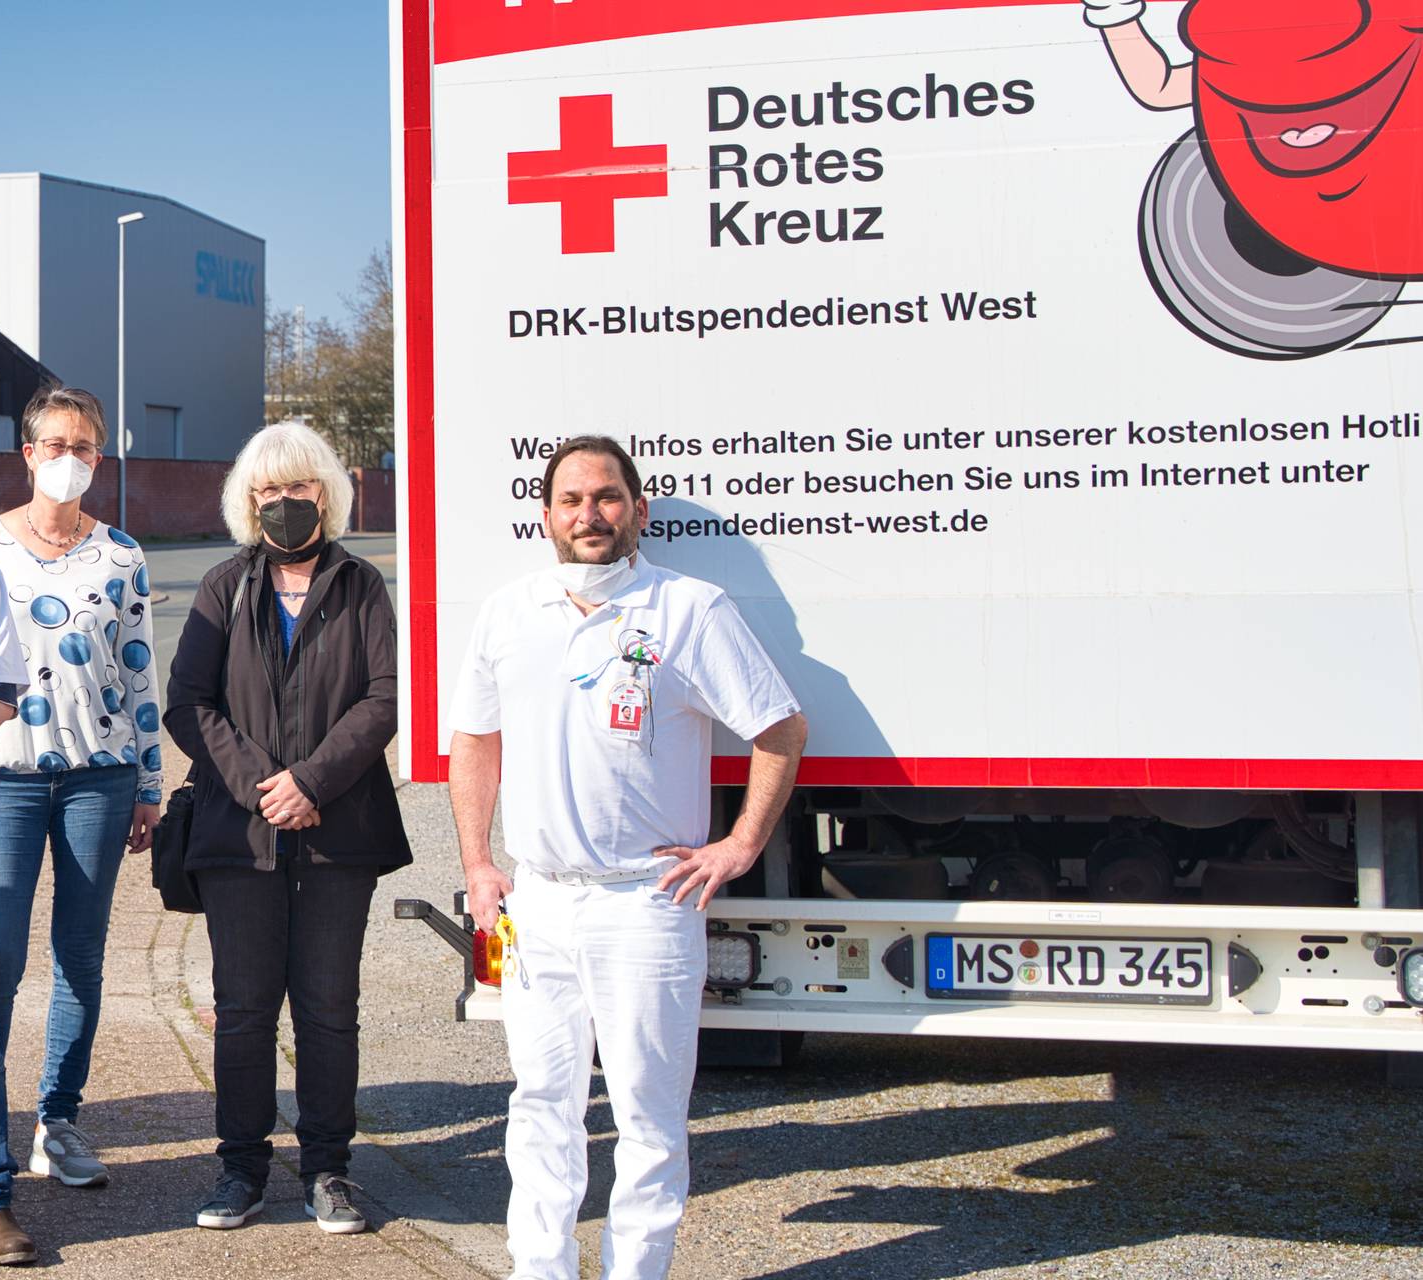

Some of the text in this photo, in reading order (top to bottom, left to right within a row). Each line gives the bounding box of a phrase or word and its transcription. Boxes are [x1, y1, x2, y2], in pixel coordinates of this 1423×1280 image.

[708, 73, 1035, 132] Deutsches
[709, 142, 884, 190] Rotes
[709, 200, 884, 248] Kreuz
[509, 291, 1037, 338] DRK-Blutspendedienst West
[630, 413, 1421, 457] Infos erhalten Sie unter unserer kostenlosen Hotli
[725, 471, 795, 496] oder
[804, 468, 953, 495] besuchen
[964, 466, 1013, 491] Sie
[1024, 470, 1080, 490] uns
[1091, 463, 1128, 488] im
[1141, 461, 1270, 487] Internet
[1281, 460, 1370, 484] unter
[936, 969, 946, 980] D
[956, 943, 1203, 988] MS RD 345
